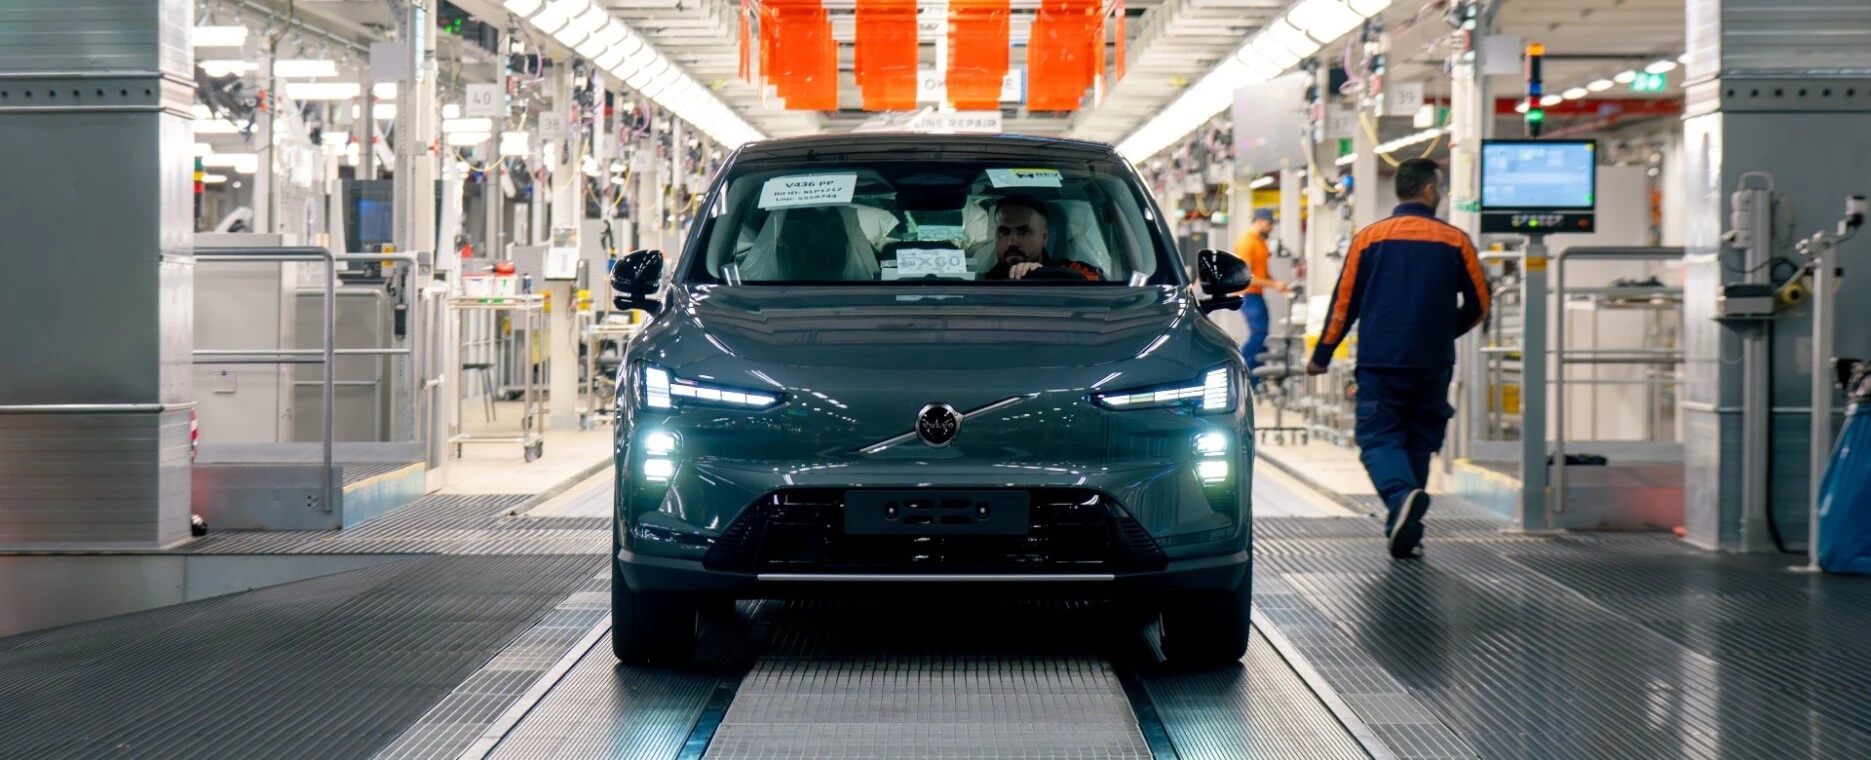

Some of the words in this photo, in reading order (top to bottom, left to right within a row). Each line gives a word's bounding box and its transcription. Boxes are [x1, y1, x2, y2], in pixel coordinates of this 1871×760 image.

[473, 92, 492, 104] 40
[1398, 89, 1414, 104] 39
[545, 118, 560, 129] 38
[948, 119, 996, 129] REPAIR
